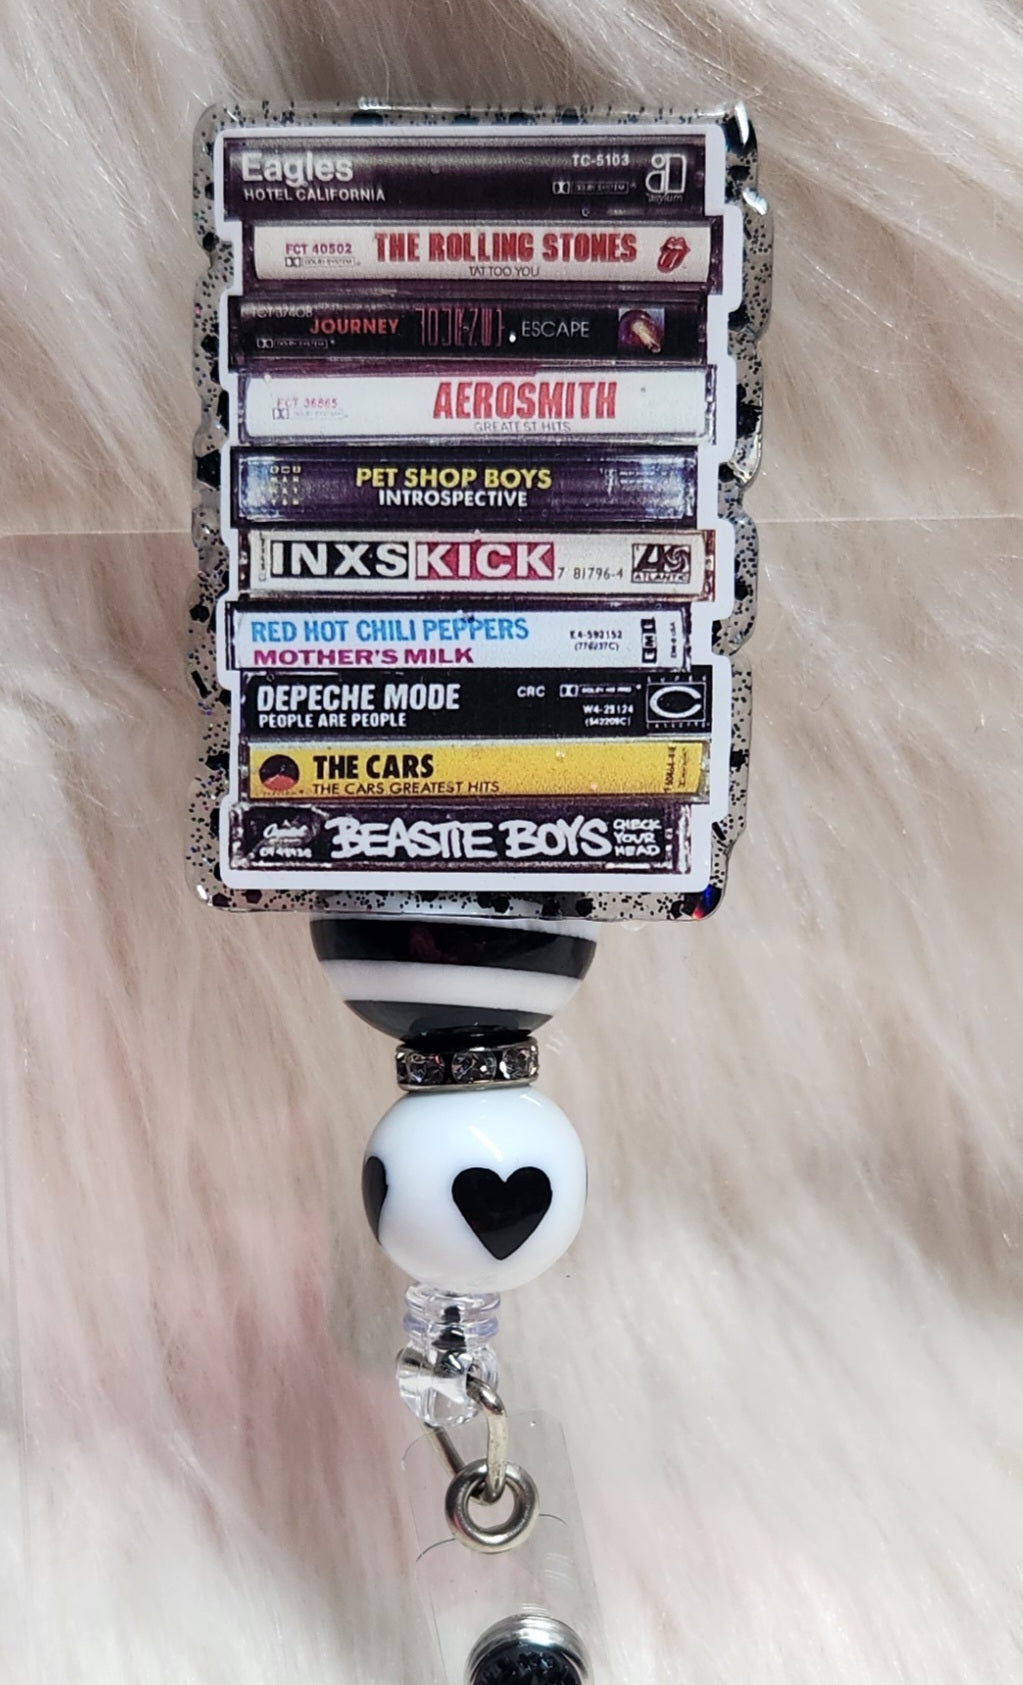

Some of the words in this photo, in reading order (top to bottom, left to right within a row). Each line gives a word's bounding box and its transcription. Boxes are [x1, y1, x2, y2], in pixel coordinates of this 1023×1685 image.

[241, 150, 354, 188] Eagles
[571, 153, 629, 167] TC-5103
[244, 187, 292, 201] HOTEL
[296, 187, 385, 201] CALIFORNIA
[285, 243, 307, 255] FCT
[312, 243, 353, 255] 40502
[374, 232, 420, 262] THE
[428, 232, 534, 263] ROLLING
[542, 232, 638, 263] STONES
[516, 265, 540, 277] YOU
[310, 317, 400, 335] JOURNEY
[521, 321, 590, 339] ESCAPE
[433, 381, 618, 420] AEROSMITH
[474, 421, 538, 433] GREATEST
[542, 421, 572, 433] HITS
[355, 467, 398, 488] PET
[404, 467, 477, 489] SHOP
[484, 468, 552, 490] BOYS
[378, 490, 528, 508] INTROSPECTIVE
[272, 542, 408, 577] INXS
[416, 543, 554, 578] KICK
[557, 567, 565, 579] 7
[573, 567, 623, 580] 81796-4
[250, 621, 297, 643] RED
[303, 620, 349, 642] HOT
[356, 619, 416, 642] CHILI
[423, 617, 529, 641] PEPPERS
[253, 648, 398, 666] MOTHER'S
[404, 647, 474, 665] MILK
[257, 685, 376, 712] DEPECHE
[384, 684, 461, 710] MODE
[517, 686, 545, 698] CRC
[259, 714, 313, 728] PEOPLE
[318, 714, 347, 727] ARE
[351, 713, 406, 727] PEOPLE
[313, 756, 359, 779] THE
[366, 754, 433, 779] CARS
[312, 783, 339, 795] THE
[344, 783, 384, 794] CARS
[389, 781, 463, 794] GREATEST
[468, 781, 500, 793] HITS
[613, 818, 662, 831] CHECK
[324, 817, 498, 859] BEASTIE
[499, 815, 612, 858] BOYS
[613, 831, 656, 844] YOUR
[614, 844, 660, 857] HEAD
